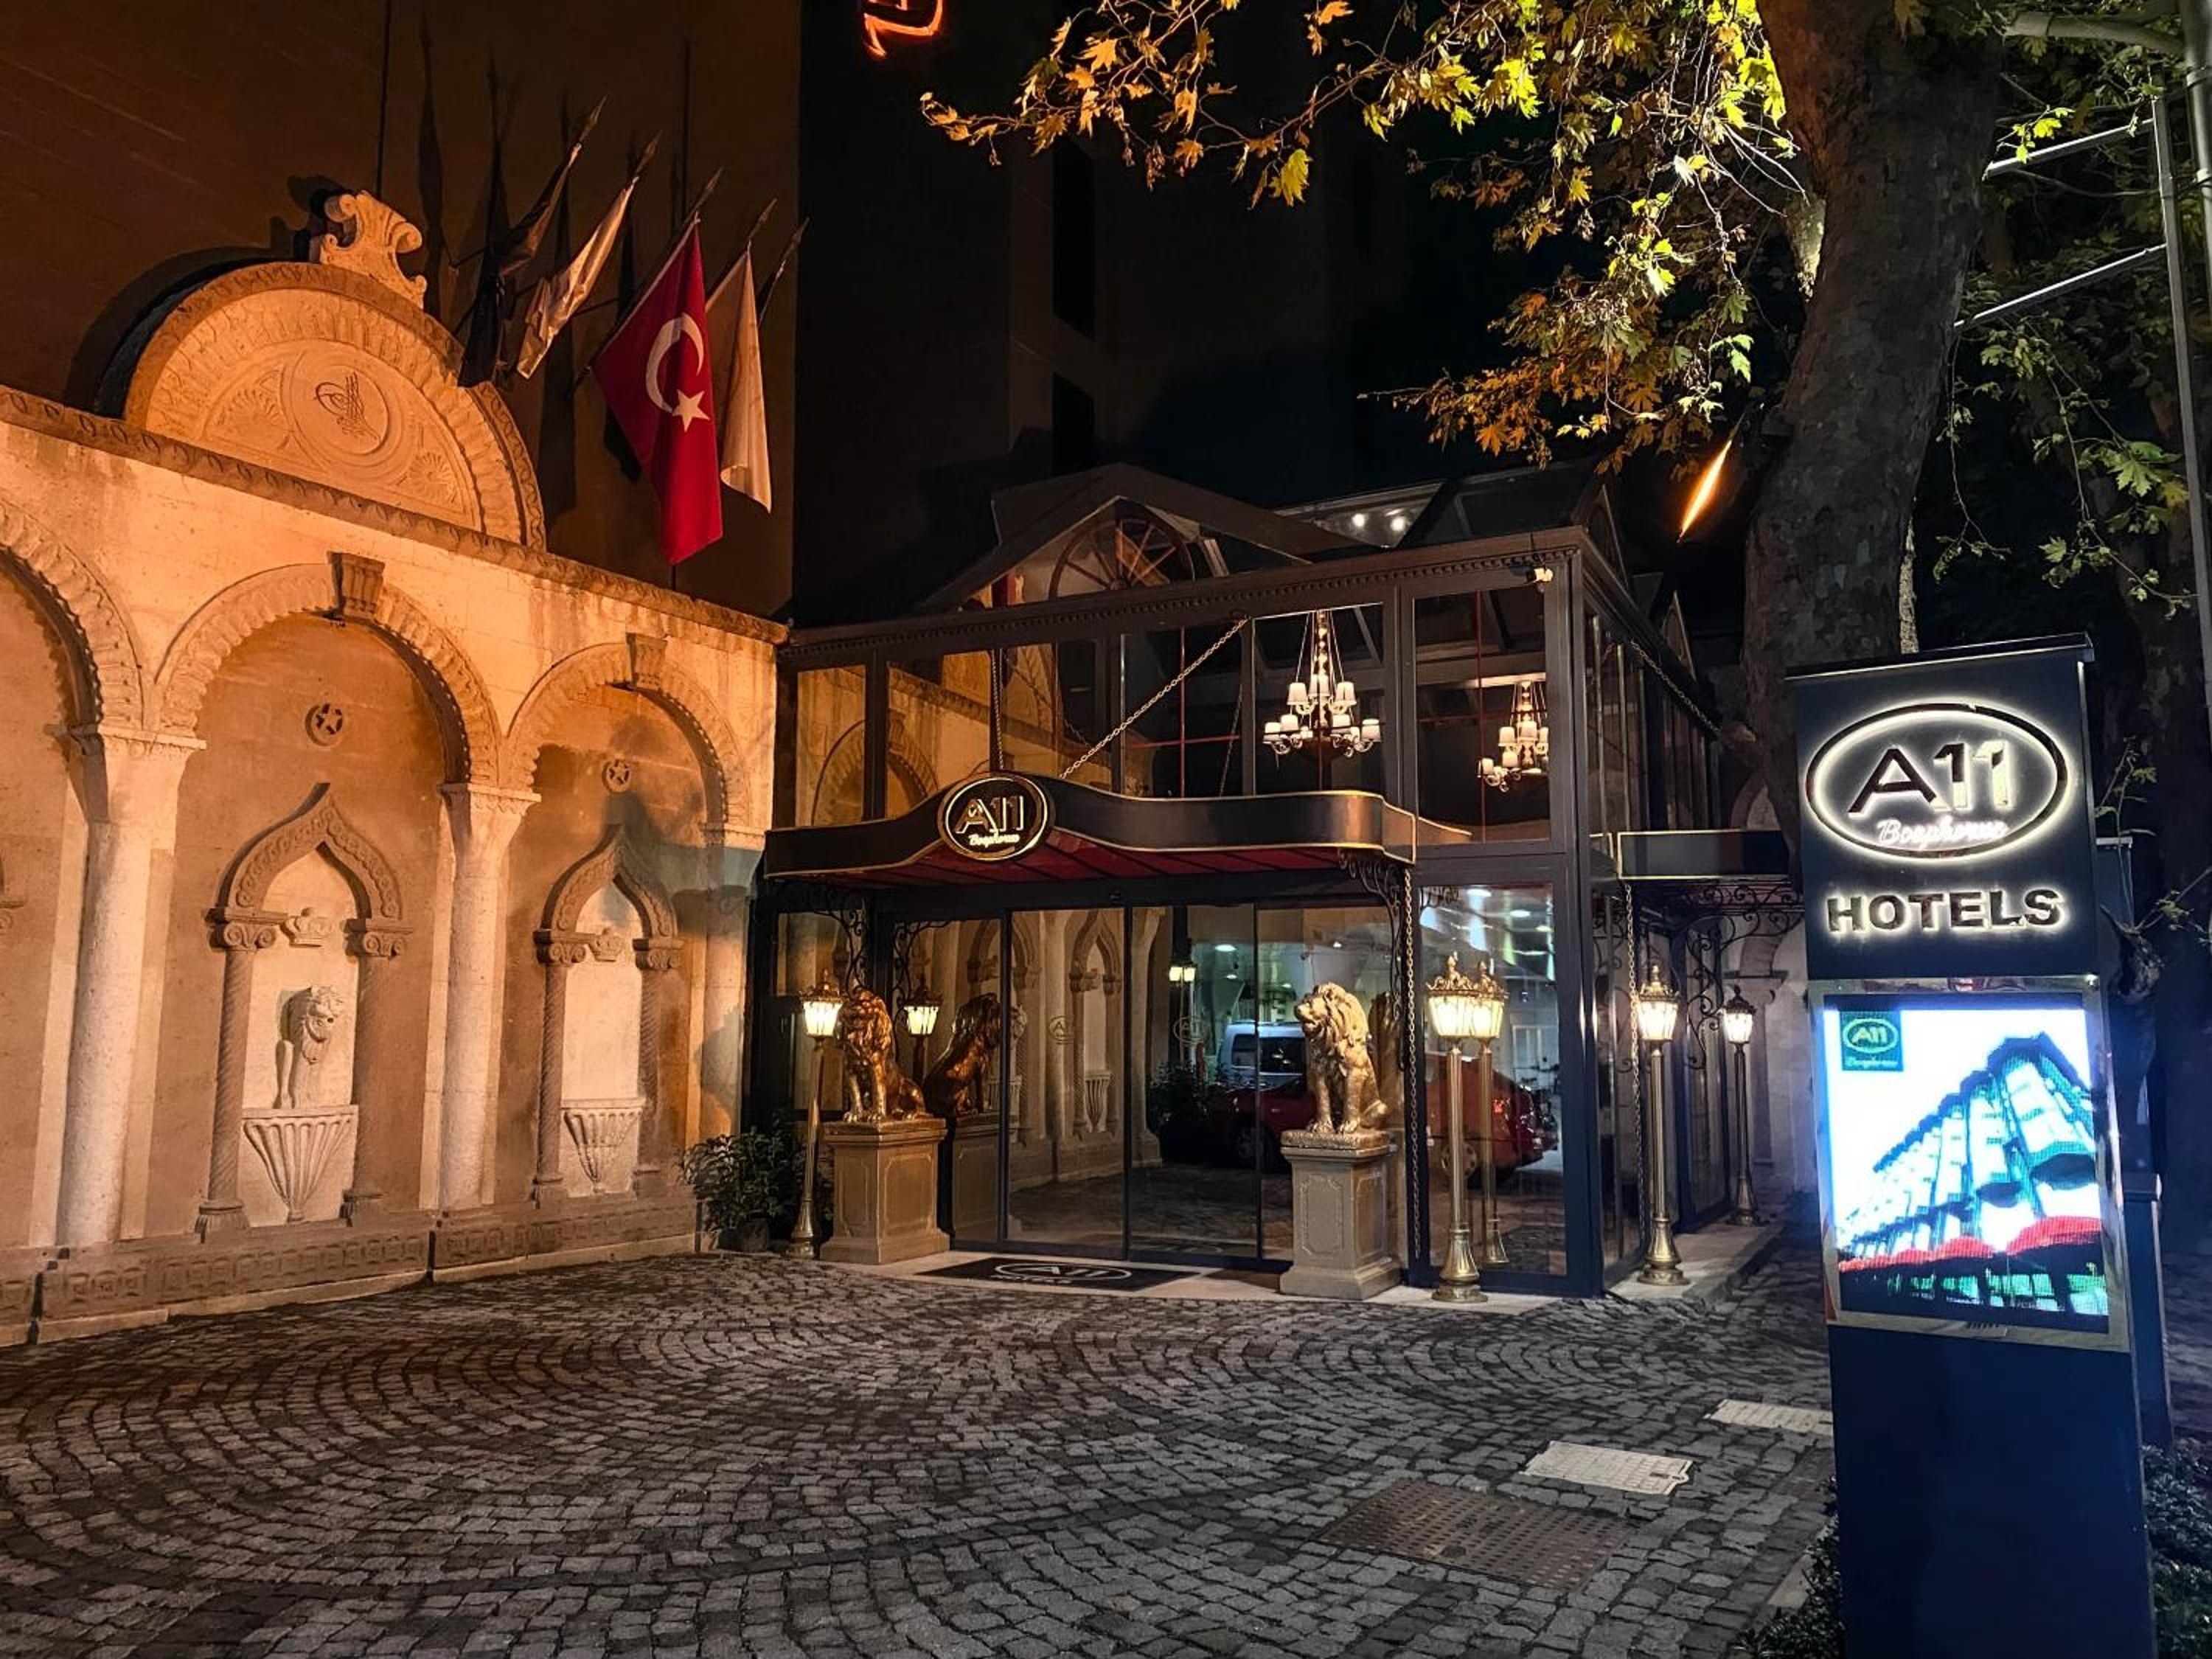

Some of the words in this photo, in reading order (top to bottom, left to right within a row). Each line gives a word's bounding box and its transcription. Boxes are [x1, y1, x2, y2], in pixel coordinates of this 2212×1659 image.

[1847, 740, 2011, 816] A11
[954, 796, 1024, 834] A11
[1826, 889, 2062, 932] HOTELS
